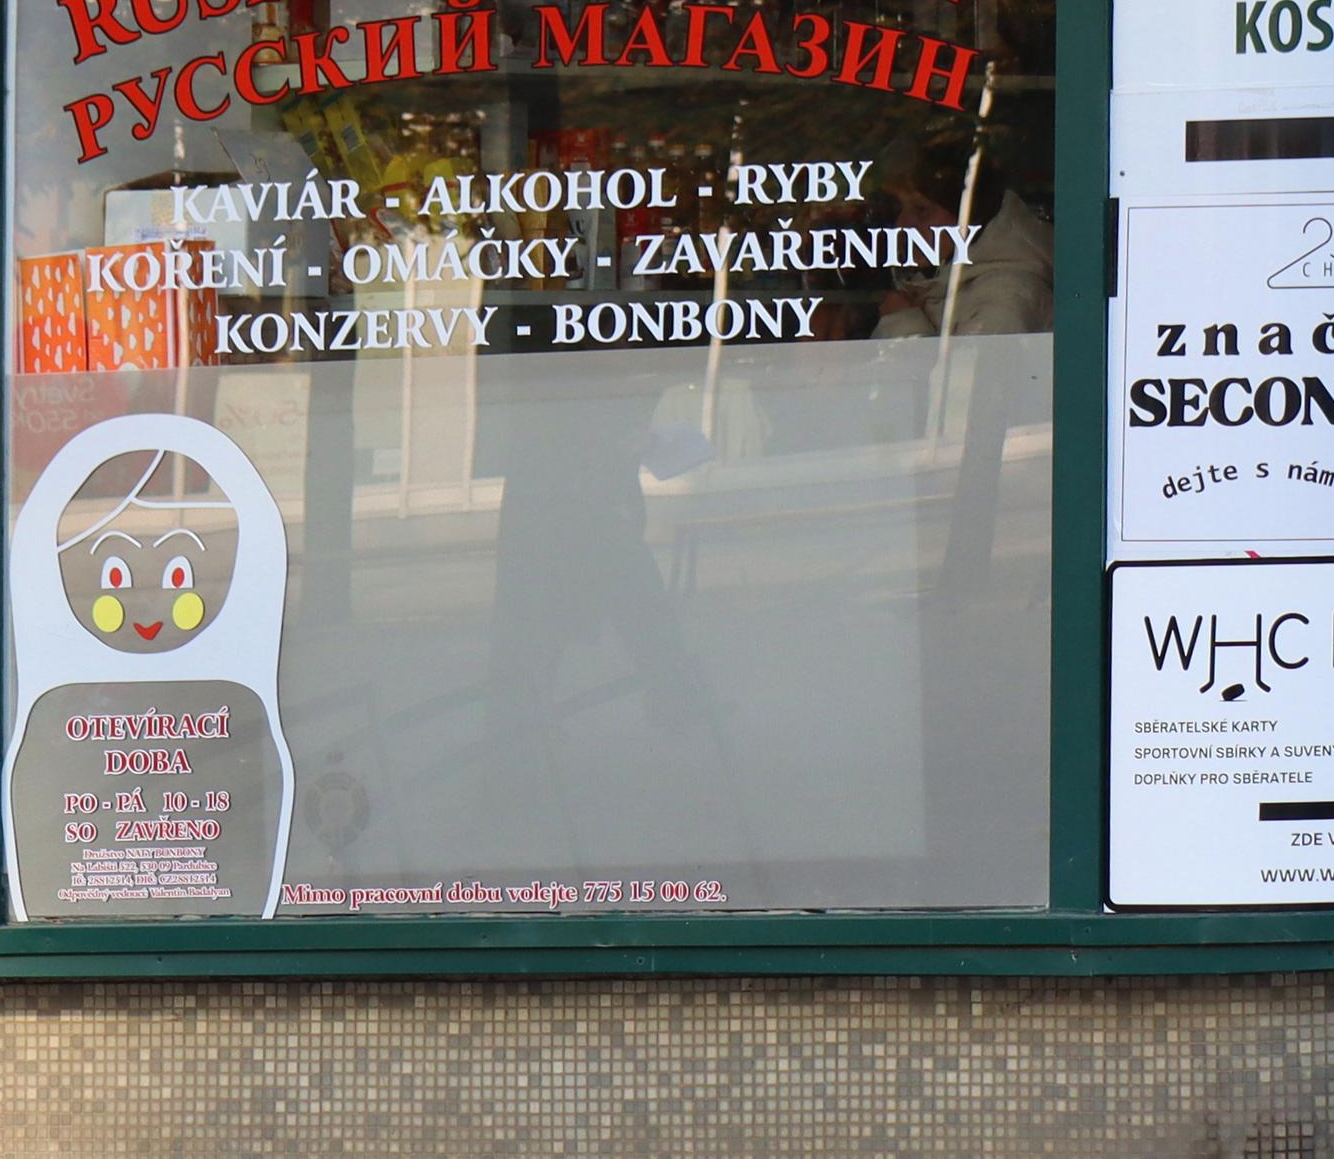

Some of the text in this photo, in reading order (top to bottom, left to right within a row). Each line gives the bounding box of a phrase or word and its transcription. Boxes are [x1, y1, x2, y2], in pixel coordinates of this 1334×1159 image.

[531, 3, 982, 111] МАГАЗИН
[170, 168, 366, 223] KAVIÁR
[418, 167, 678, 216] ALKOHOL
[734, 160, 874, 205] RYBY
[86, 234, 288, 293] KOŘENÍ
[343, 226, 579, 285] OMÁČKY
[632, 217, 983, 276] ZAVAŘENINY
[215, 306, 499, 354] KONZERVY
[551, 297, 823, 344] BONBONY
[1163, 463, 1238, 498] dejte
[1256, 462, 1269, 478] s
[1144, 613, 1310, 694] WHC
[66, 706, 230, 741] OTEVÍRACÍ
[1134, 718, 1278, 734] SBĚRATELSKÉ KARTY
[104, 749, 192, 775] DOBA
[1134, 744, 1213, 759] SPORTOVNÍ
[1216, 744, 1267, 759] SBÍRKY
[1270, 746, 1280, 758] A
[1134, 770, 1313, 785] DOPLŇKY PRO SBĚRATELE
[64, 793, 98, 814] PO
[115, 787, 146, 813] PÁ
[163, 792, 187, 812] 10
[205, 791, 230, 812] 18
[65, 815, 221, 843] SO ZAVŘENO
[1291, 832, 1323, 846] ZDE
[83, 848, 125, 859] Družstvo
[154, 847, 207, 858] BONBONY
[171, 860, 218, 872] Pardubice
[282, 879, 728, 909] Mimo pracovní dobu volejte 775 15 00 62.
